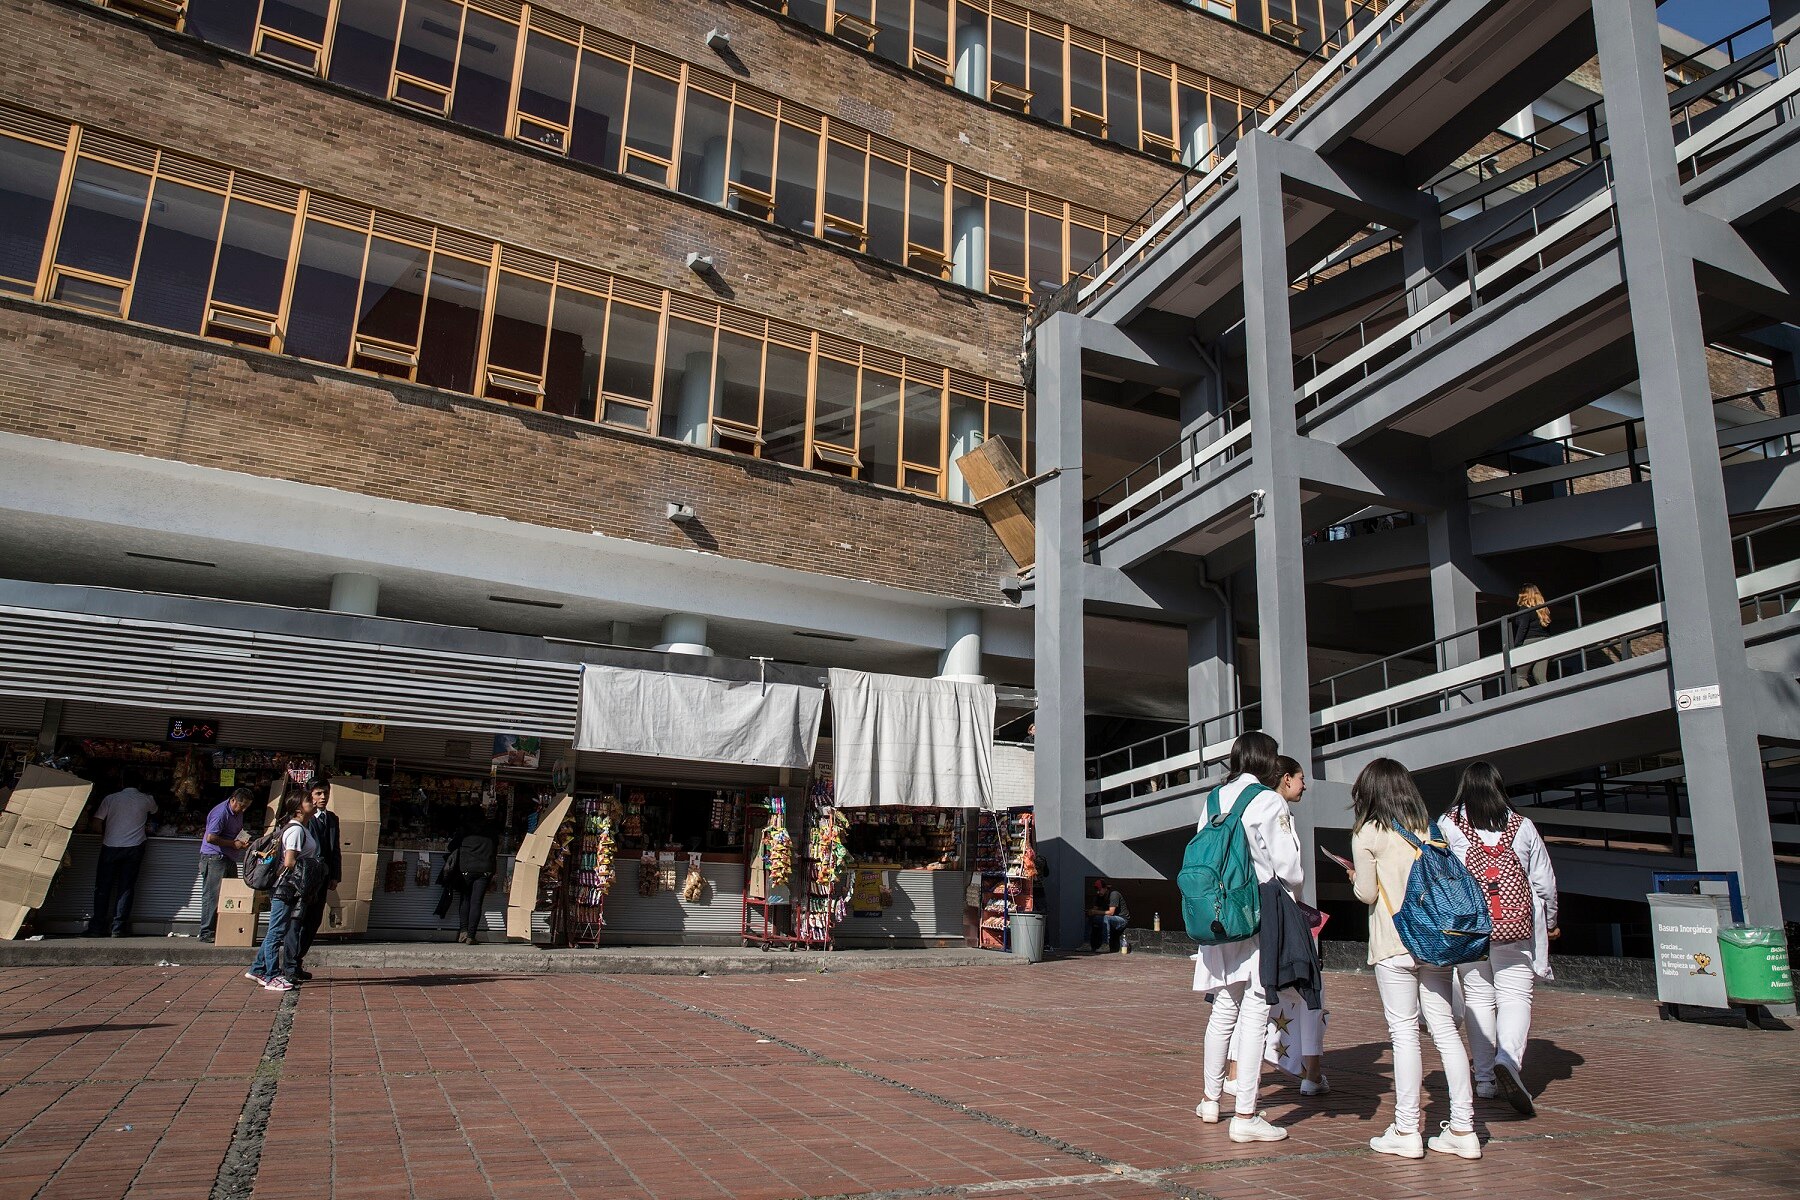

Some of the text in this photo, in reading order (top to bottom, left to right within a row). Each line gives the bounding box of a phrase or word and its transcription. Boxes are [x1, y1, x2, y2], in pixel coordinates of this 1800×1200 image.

[184, 724, 214, 738] CAFE
[1659, 924, 1712, 934] Basura Inorgánica
[1670, 952, 1685, 960] hacer
[1667, 961, 1688, 969] limpieza
